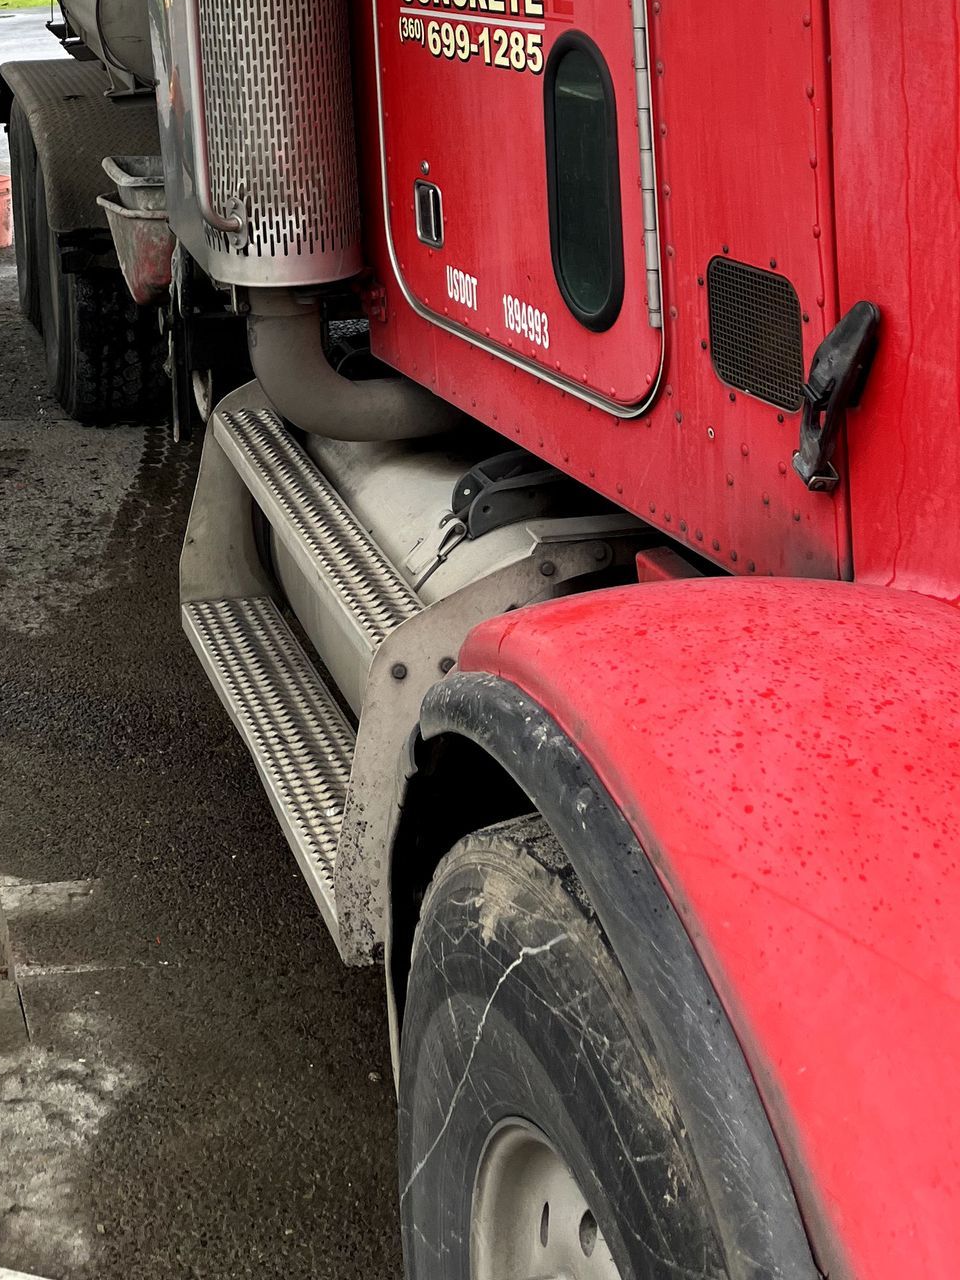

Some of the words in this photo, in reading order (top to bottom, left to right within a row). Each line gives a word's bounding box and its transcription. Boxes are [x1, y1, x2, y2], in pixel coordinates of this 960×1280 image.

[398, 16, 426, 47] (360)
[426, 19, 545, 75] 699-1285
[446, 264, 478, 311] USDOT
[502, 293, 550, 349] 1894993
